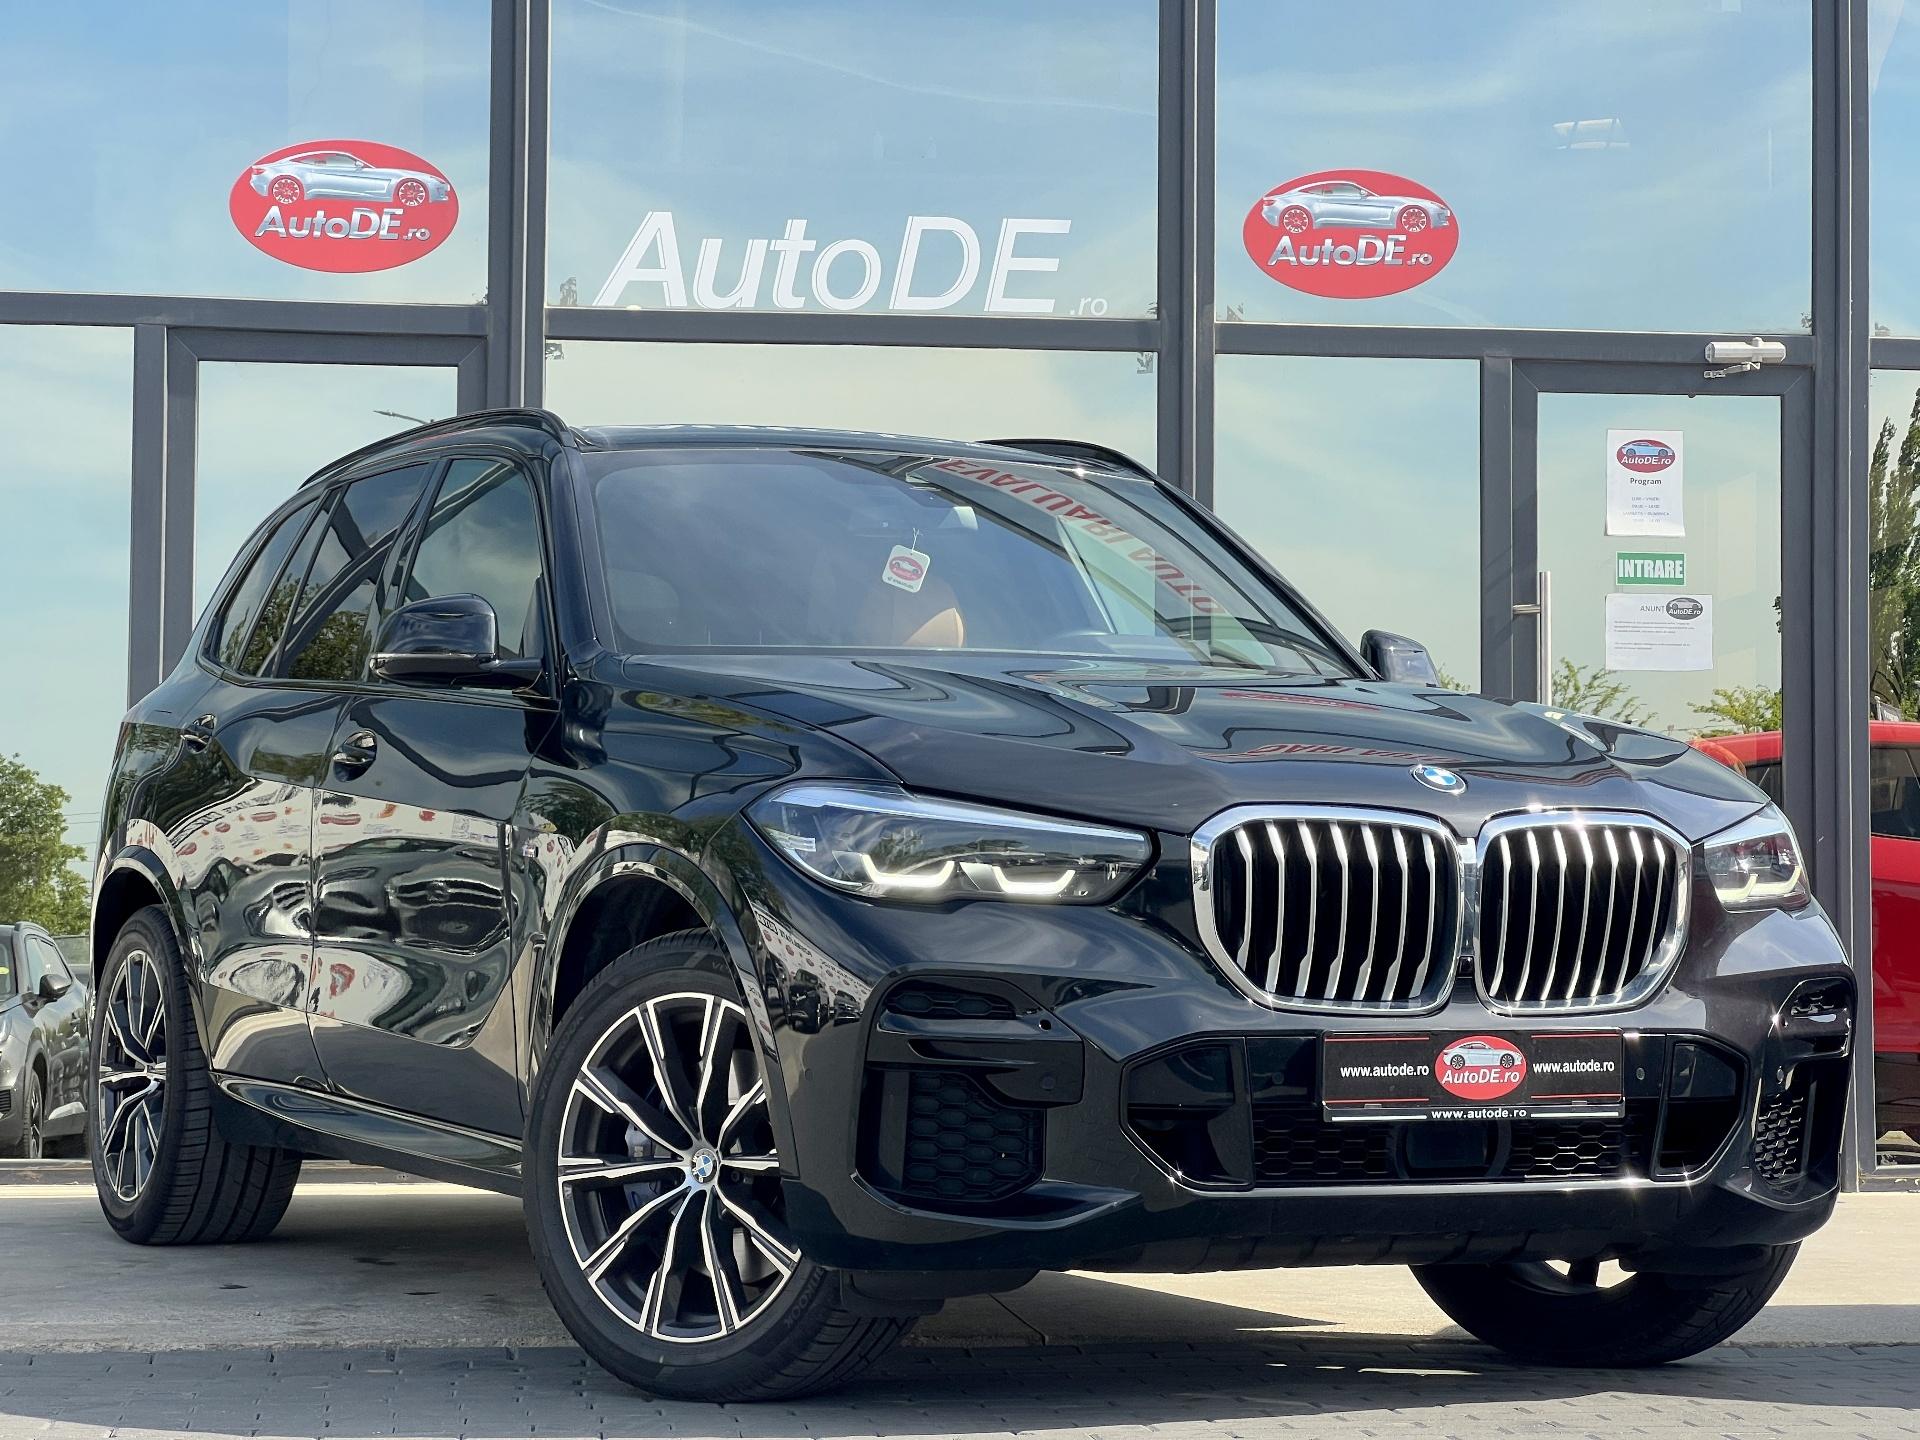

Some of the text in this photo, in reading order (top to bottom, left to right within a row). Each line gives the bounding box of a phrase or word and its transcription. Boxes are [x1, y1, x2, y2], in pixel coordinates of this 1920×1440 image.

[1620, 456, 1671, 465] AutoDE.ro
[1630, 477, 1661, 486] Program
[1618, 559, 1684, 578] INTRARE
[1668, 608, 1701, 616] AutoDE.ro
[1340, 1062, 1430, 1077] www.autode.ro
[1533, 1059, 1615, 1074] www.autode.ro
[1441, 1068, 1520, 1085] AutoDE.ro
[1431, 1107, 1527, 1119] www.autode.ro
